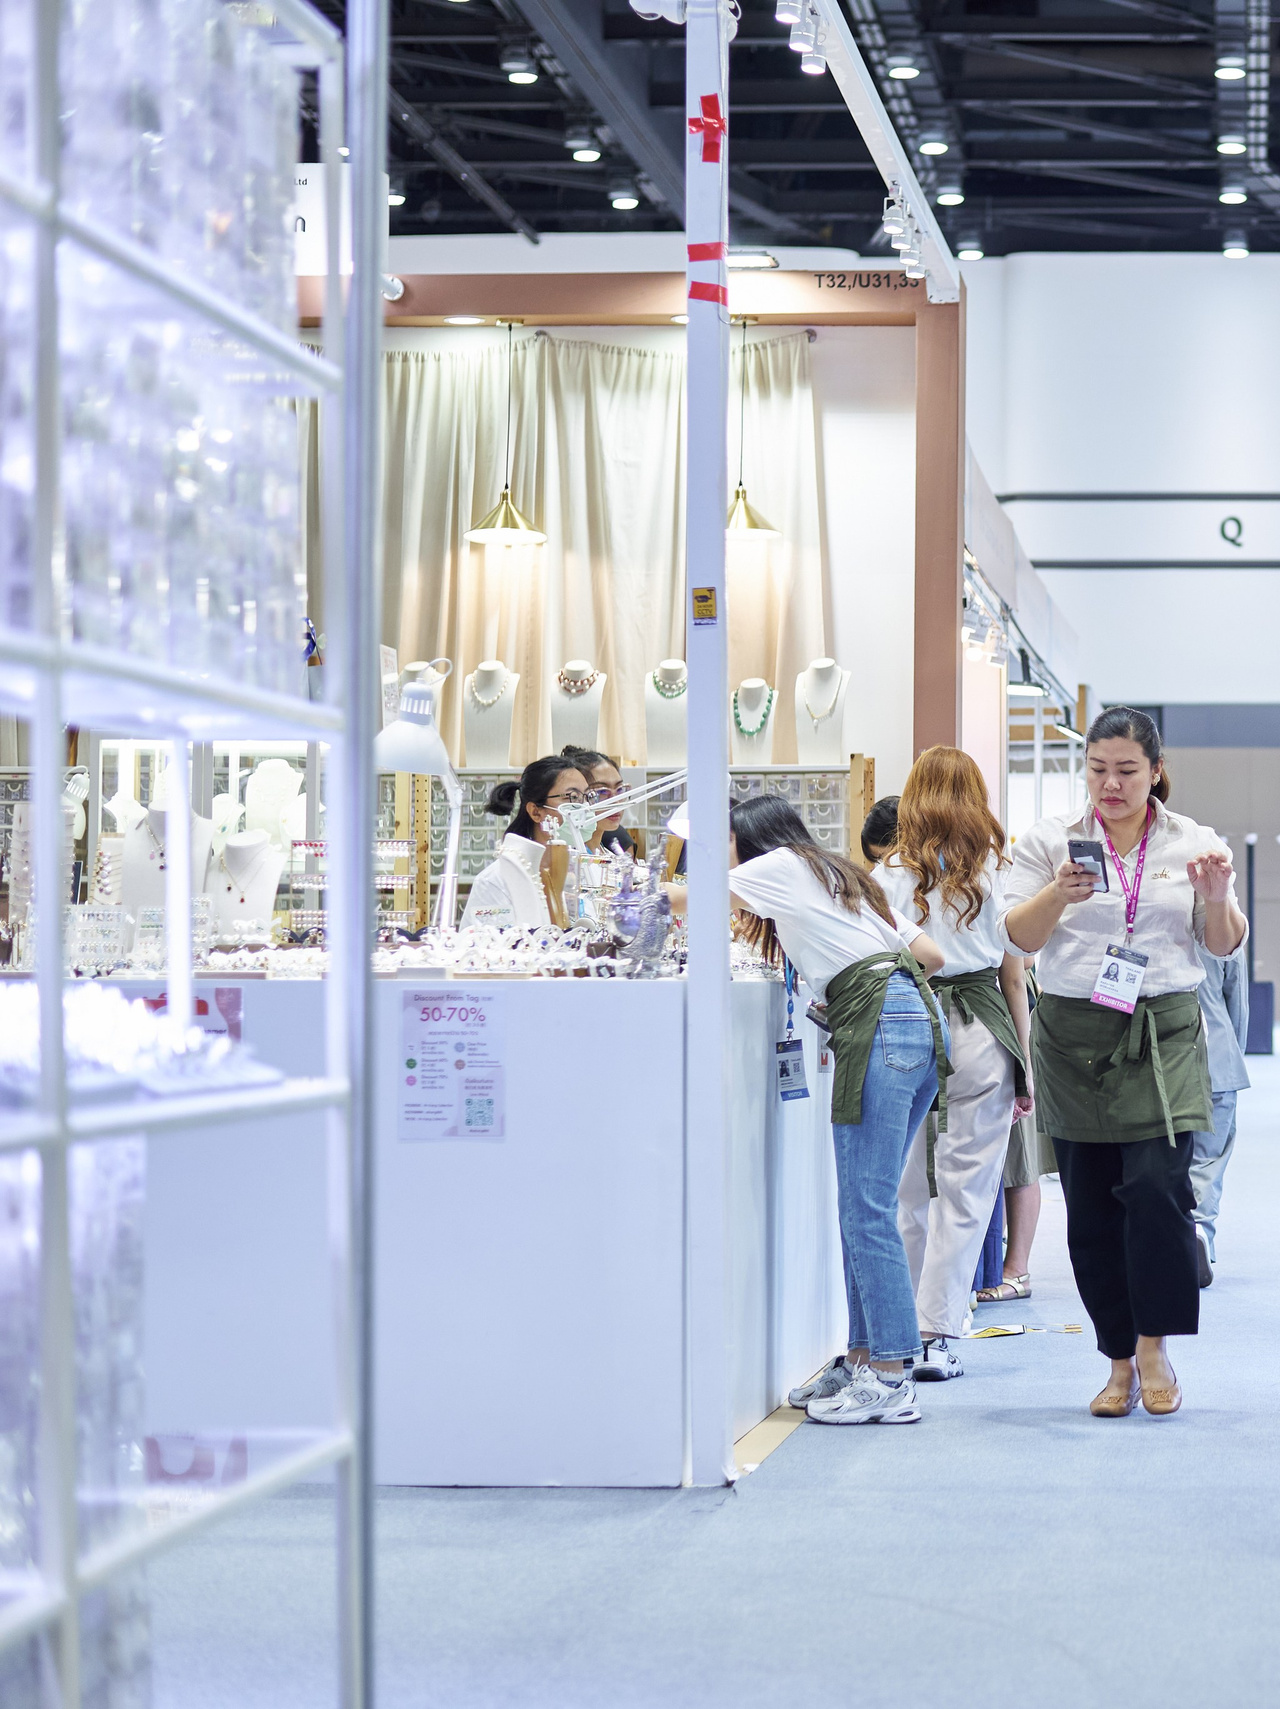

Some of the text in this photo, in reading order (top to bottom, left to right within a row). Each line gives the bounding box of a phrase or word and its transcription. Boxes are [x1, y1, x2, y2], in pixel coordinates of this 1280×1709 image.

[1221, 517, 1242, 547] Q
[466, 994, 479, 1003] Tag
[1099, 995, 1128, 1009] EXHIBITOR
[420, 1007, 486, 1022] 50-70%
